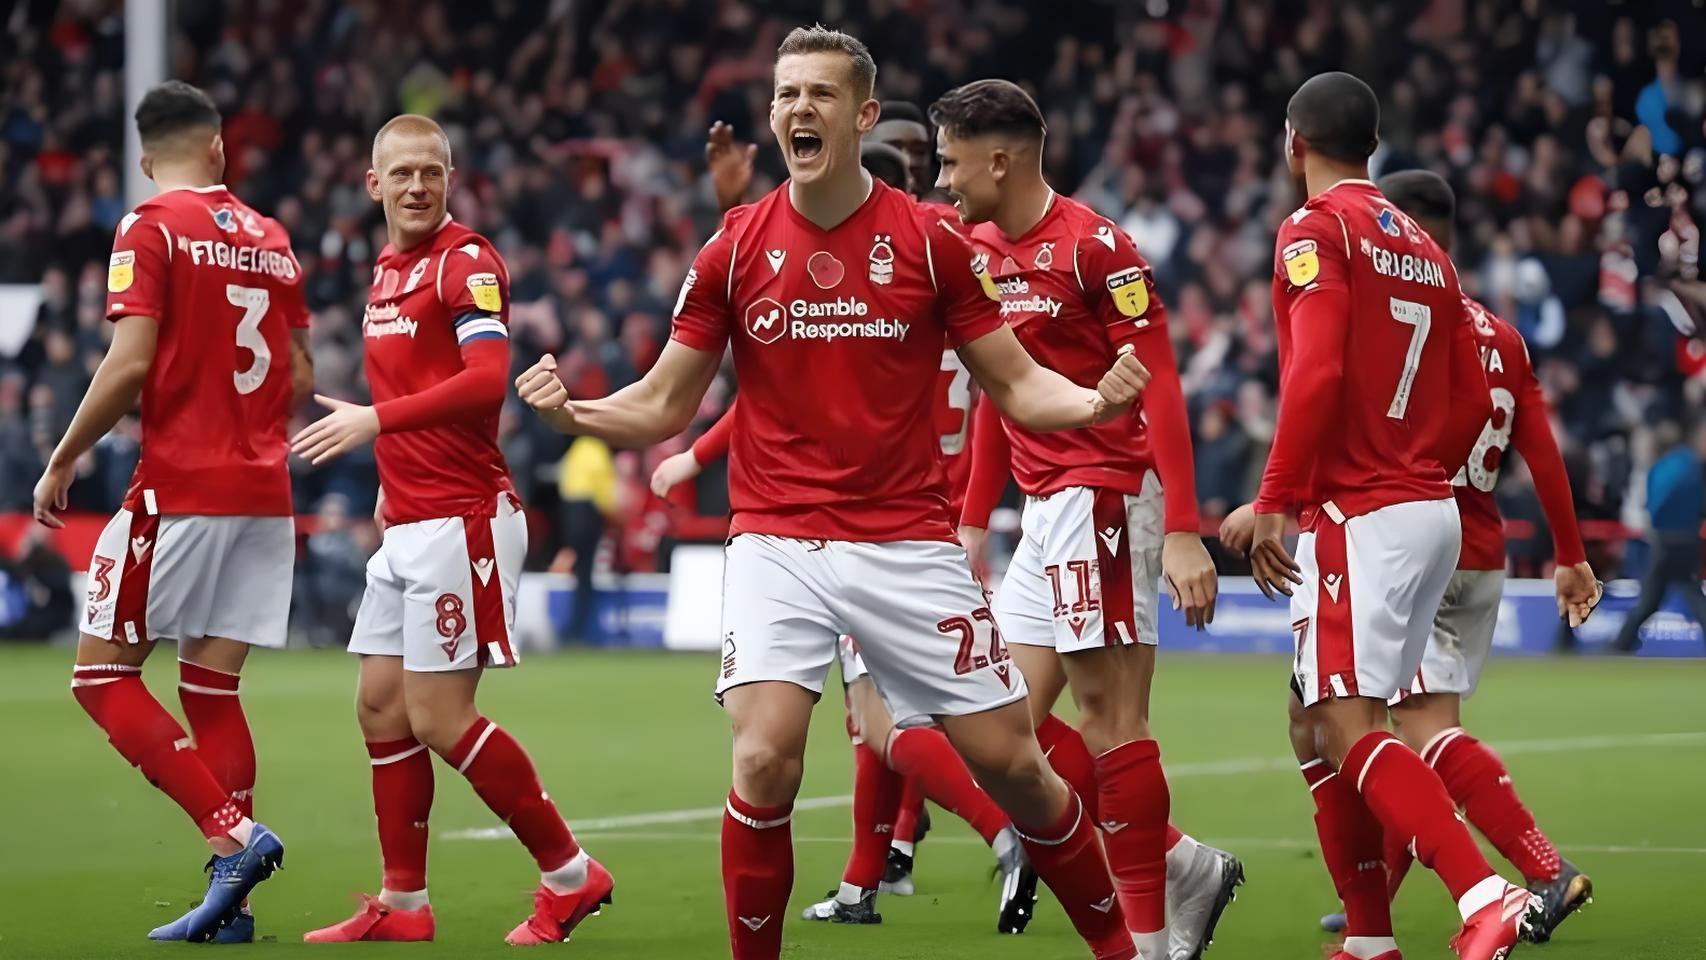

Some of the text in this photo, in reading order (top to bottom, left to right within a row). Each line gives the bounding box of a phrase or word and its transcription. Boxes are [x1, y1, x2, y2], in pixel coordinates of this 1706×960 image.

[790, 296, 868, 317] Gamble
[791, 318, 910, 343] Responsibly
[226, 283, 272, 395] 3
[1386, 296, 1432, 420] 7
[1450, 387, 1516, 493] 8
[94, 554, 116, 603] 3
[1045, 560, 1100, 618] 11
[435, 593, 467, 640] 8
